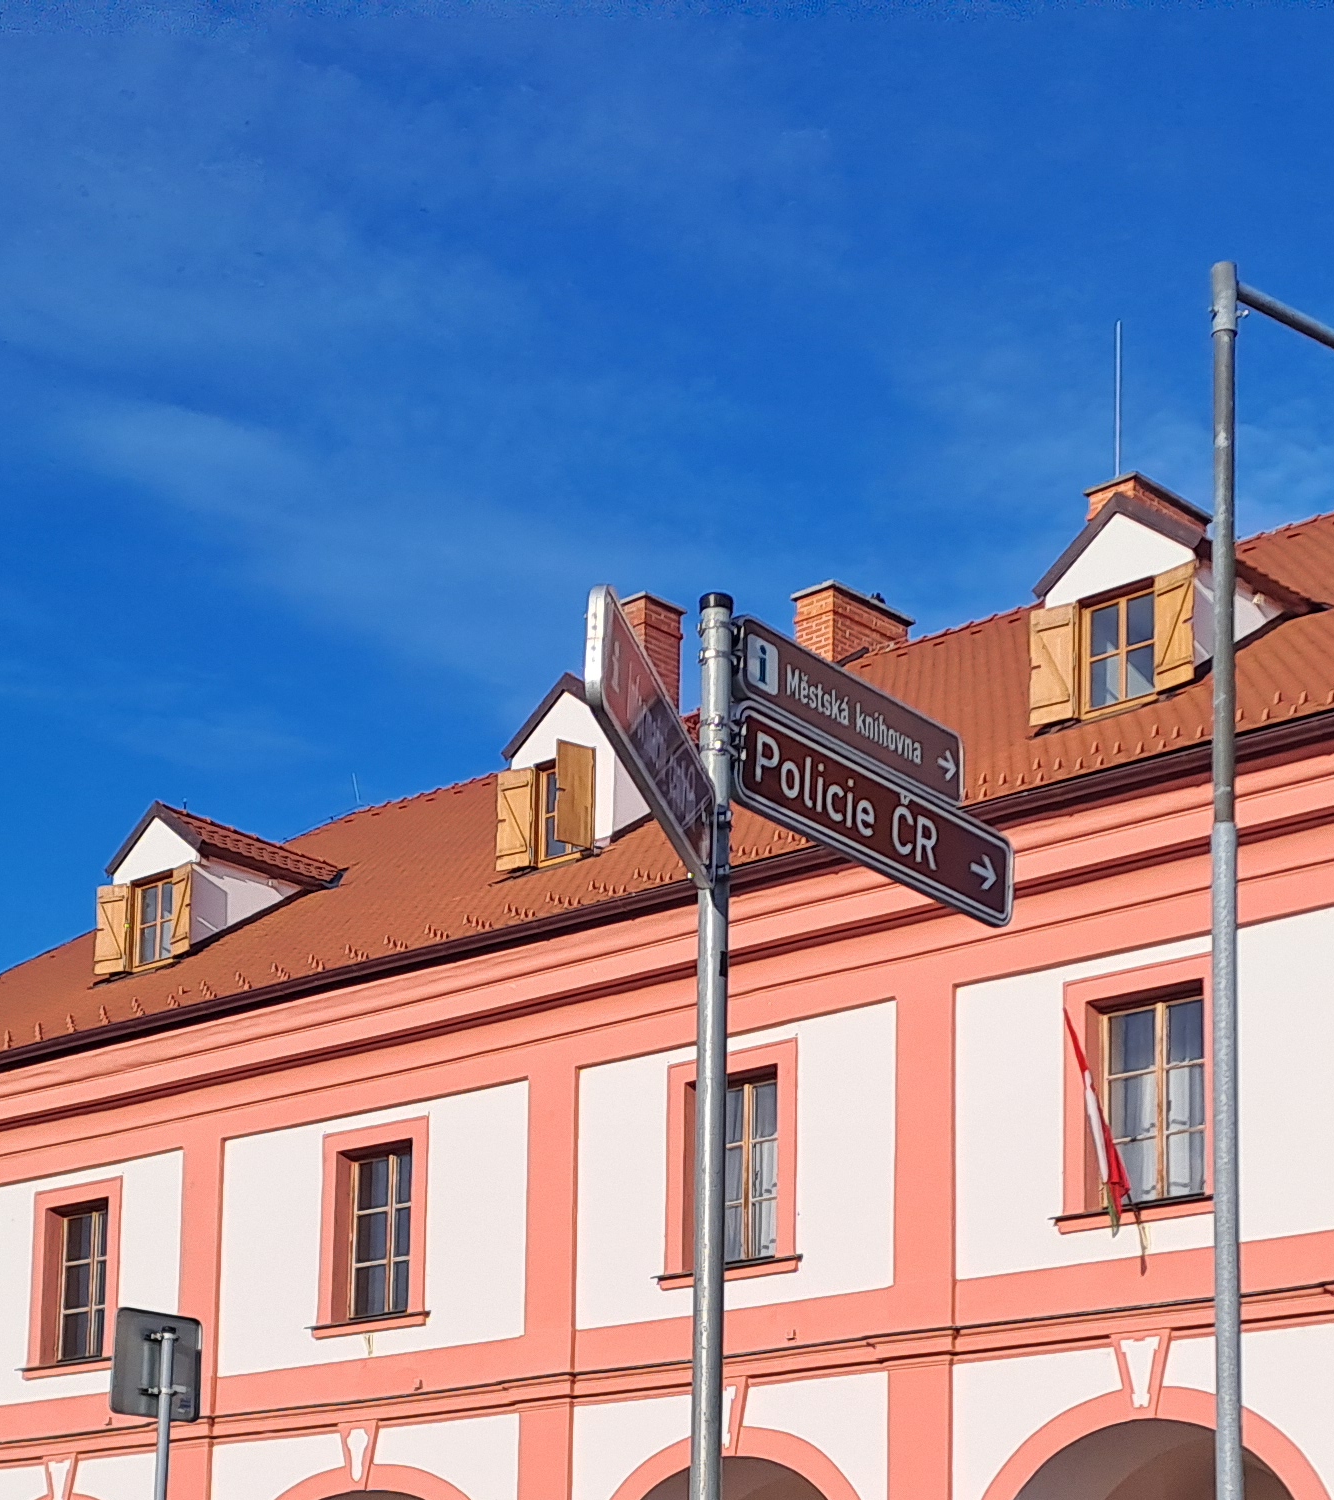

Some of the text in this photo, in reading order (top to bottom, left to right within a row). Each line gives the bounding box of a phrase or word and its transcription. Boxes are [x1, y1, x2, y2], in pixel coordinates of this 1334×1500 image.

[786, 664, 850, 727] Městská
[855, 702, 923, 764] knihovna
[755, 731, 875, 837] Policie
[892, 792, 938, 872] ČR
